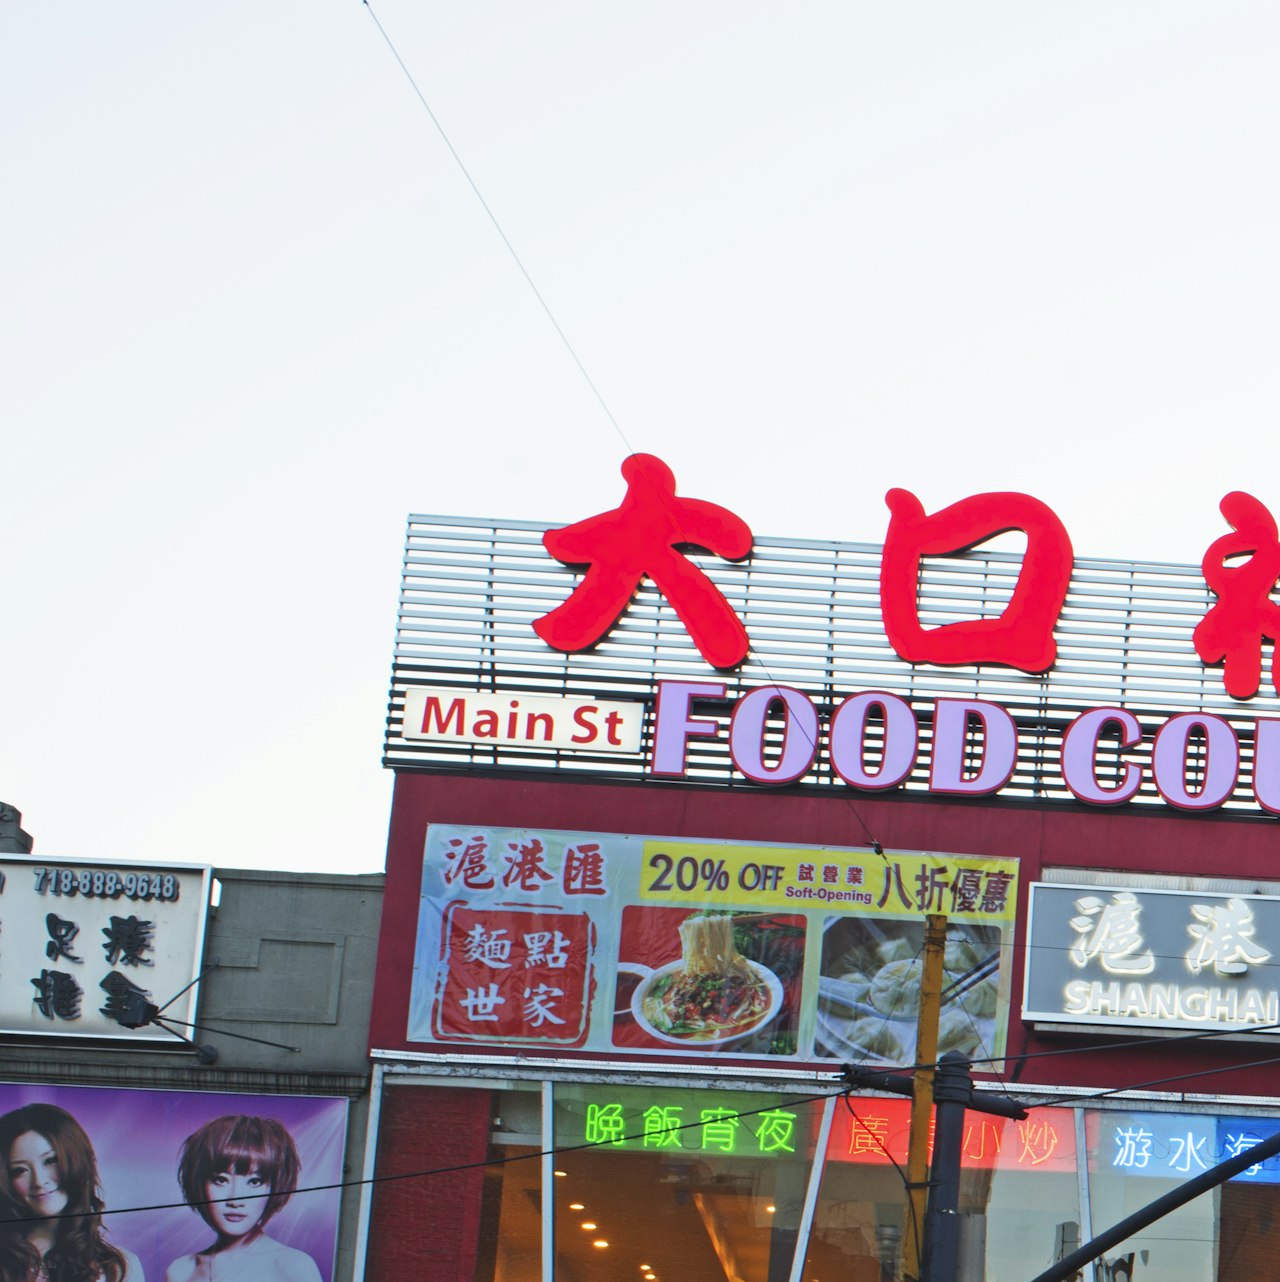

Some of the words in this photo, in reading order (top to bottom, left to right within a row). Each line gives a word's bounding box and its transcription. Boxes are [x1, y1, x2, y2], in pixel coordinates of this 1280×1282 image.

[420, 696, 555, 742] Main
[571, 706, 624, 747] St
[651, 679, 1018, 796] FOOD
[33, 868, 179, 899] 718-888-9648
[646, 852, 731, 895] 20%
[738, 861, 786, 892] OFF
[785, 885, 873, 906] Soft-Opening
[459, 981, 567, 1028] 世家
[1062, 978, 1278, 1025] SHANGHAI
[585, 1103, 798, 1154] 晚飯宵夜
